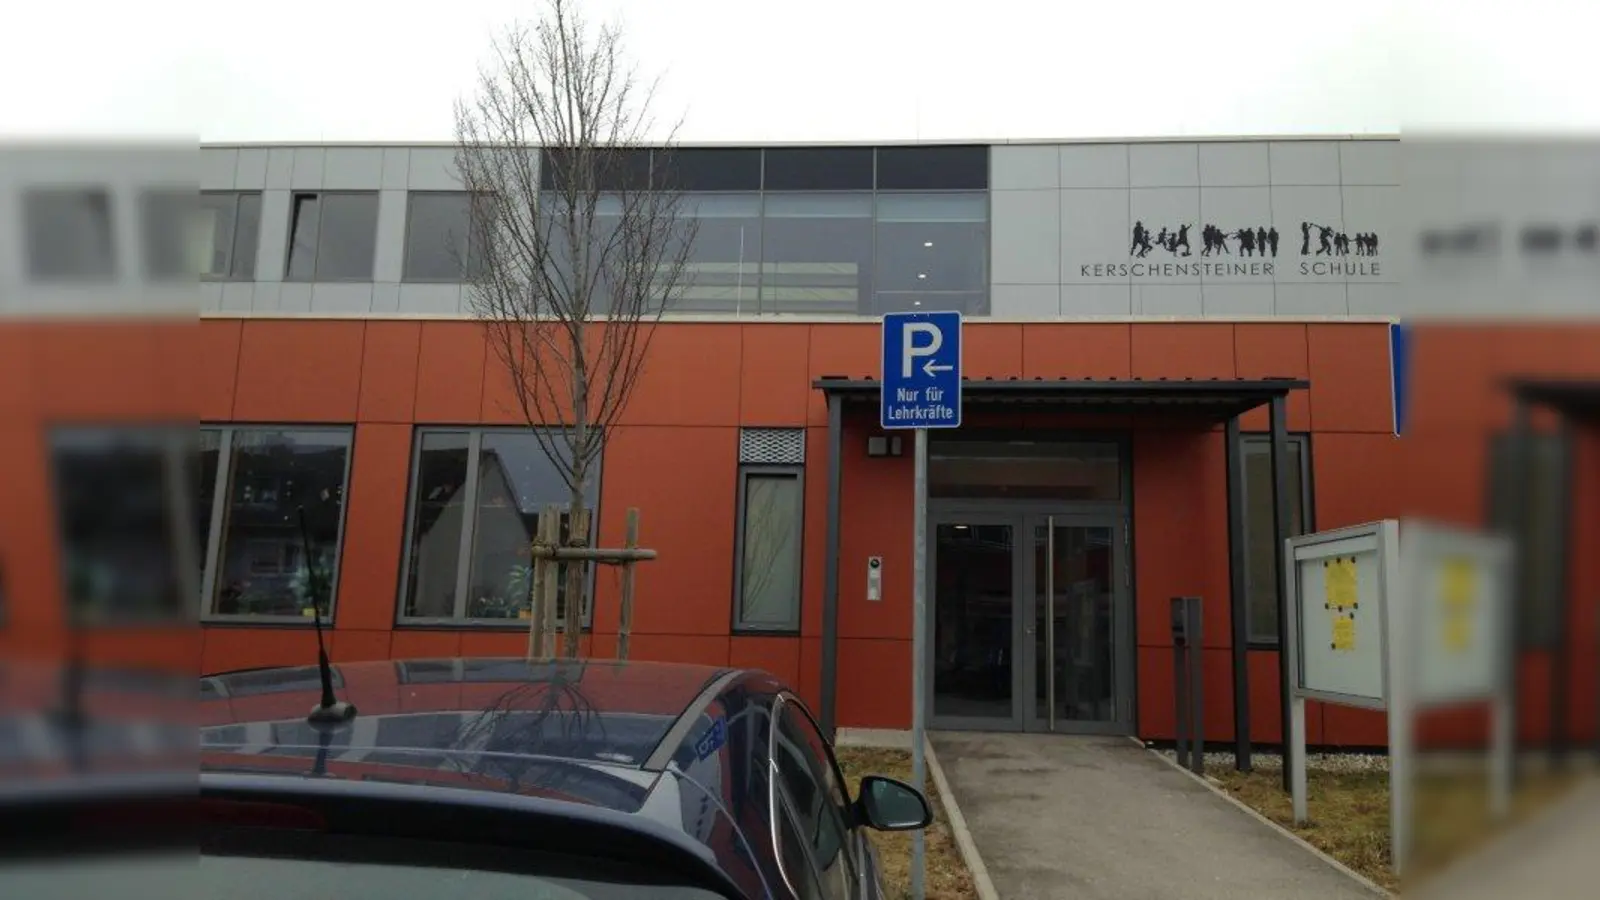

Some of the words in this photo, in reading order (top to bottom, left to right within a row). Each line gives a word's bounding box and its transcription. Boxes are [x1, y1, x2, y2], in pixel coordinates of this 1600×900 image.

[1080, 262, 1275, 277] KERSCHENSTEINER
[1300, 261, 1381, 276] SCHULE
[902, 322, 943, 378] P
[896, 387, 919, 402] Nur
[925, 386, 944, 401] für
[888, 405, 953, 419] Lehrkräfte
